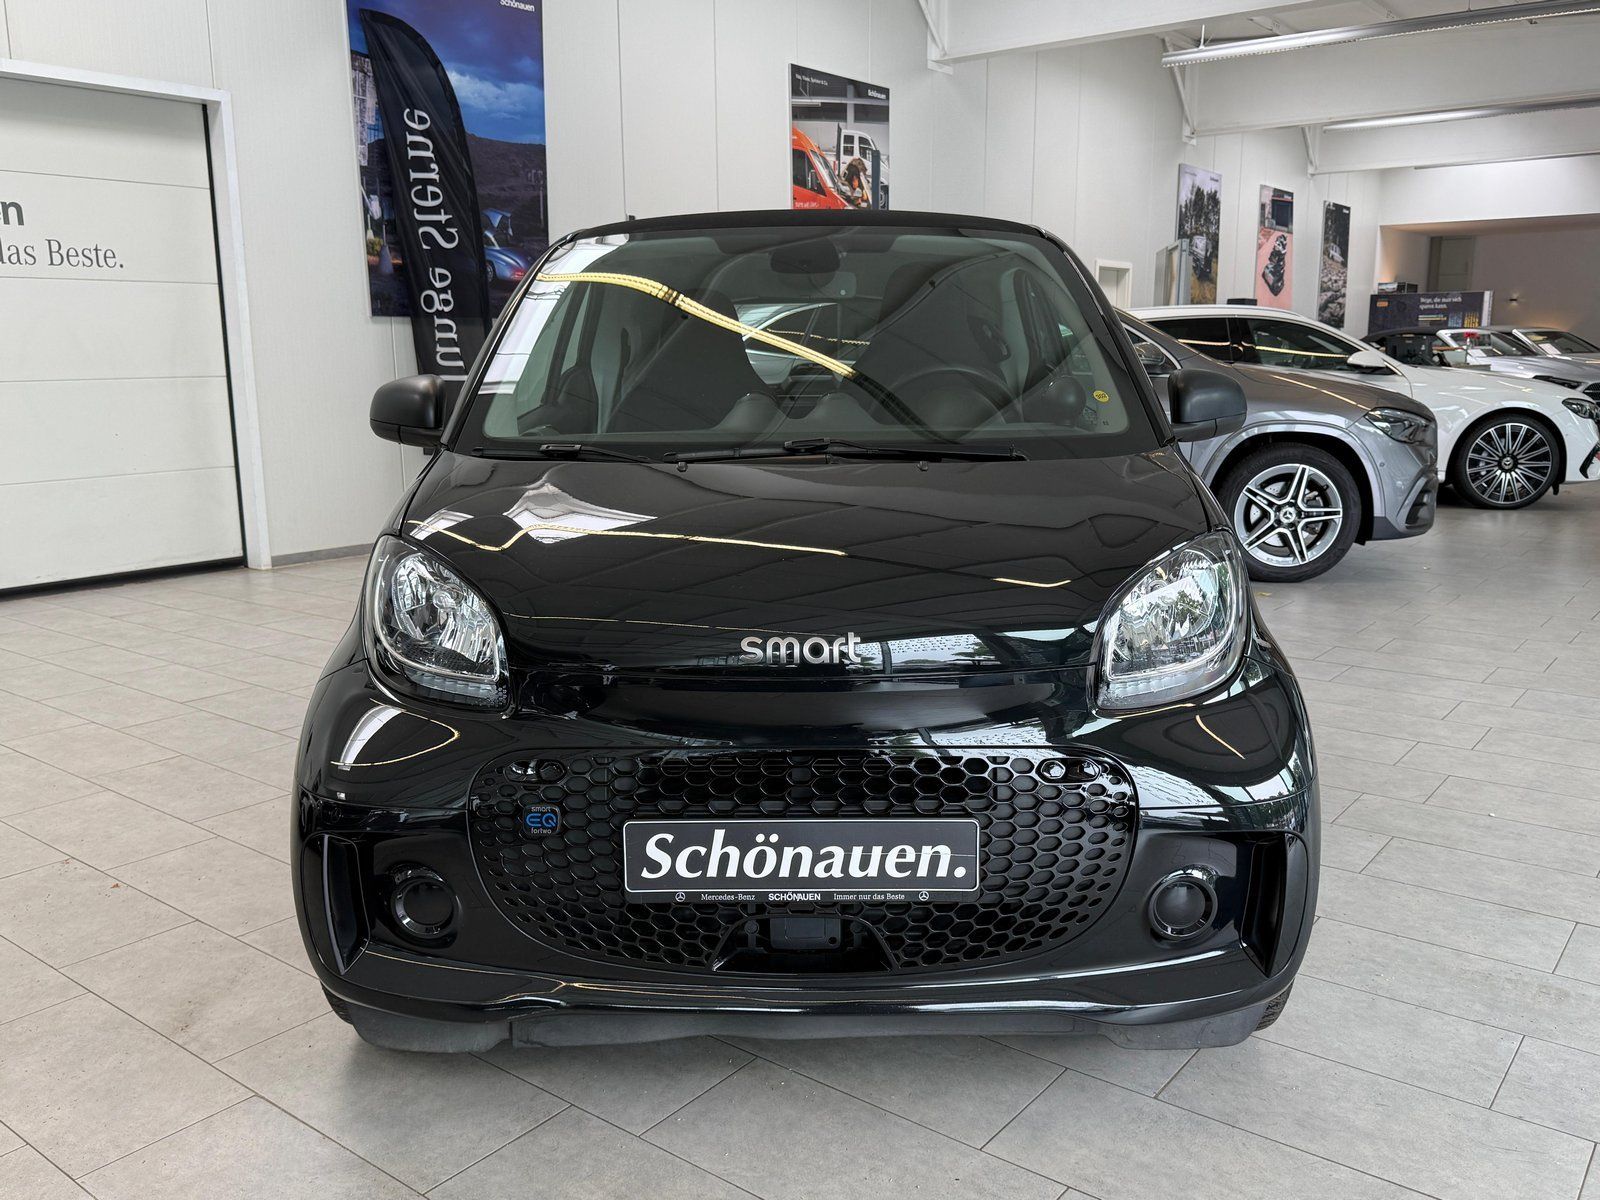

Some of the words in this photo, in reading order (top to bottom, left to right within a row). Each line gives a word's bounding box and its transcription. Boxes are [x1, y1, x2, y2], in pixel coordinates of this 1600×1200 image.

[0, 201, 24, 226] n
[45, 238, 124, 268] Beste.
[740, 632, 861, 664] smart
[526, 813, 557, 828] EQ
[640, 828, 967, 880] Schönauen.
[701, 893, 756, 901] Mercedes-Benz
[768, 892, 821, 901] SCHÖNAUEN
[872, 892, 886, 900] das
